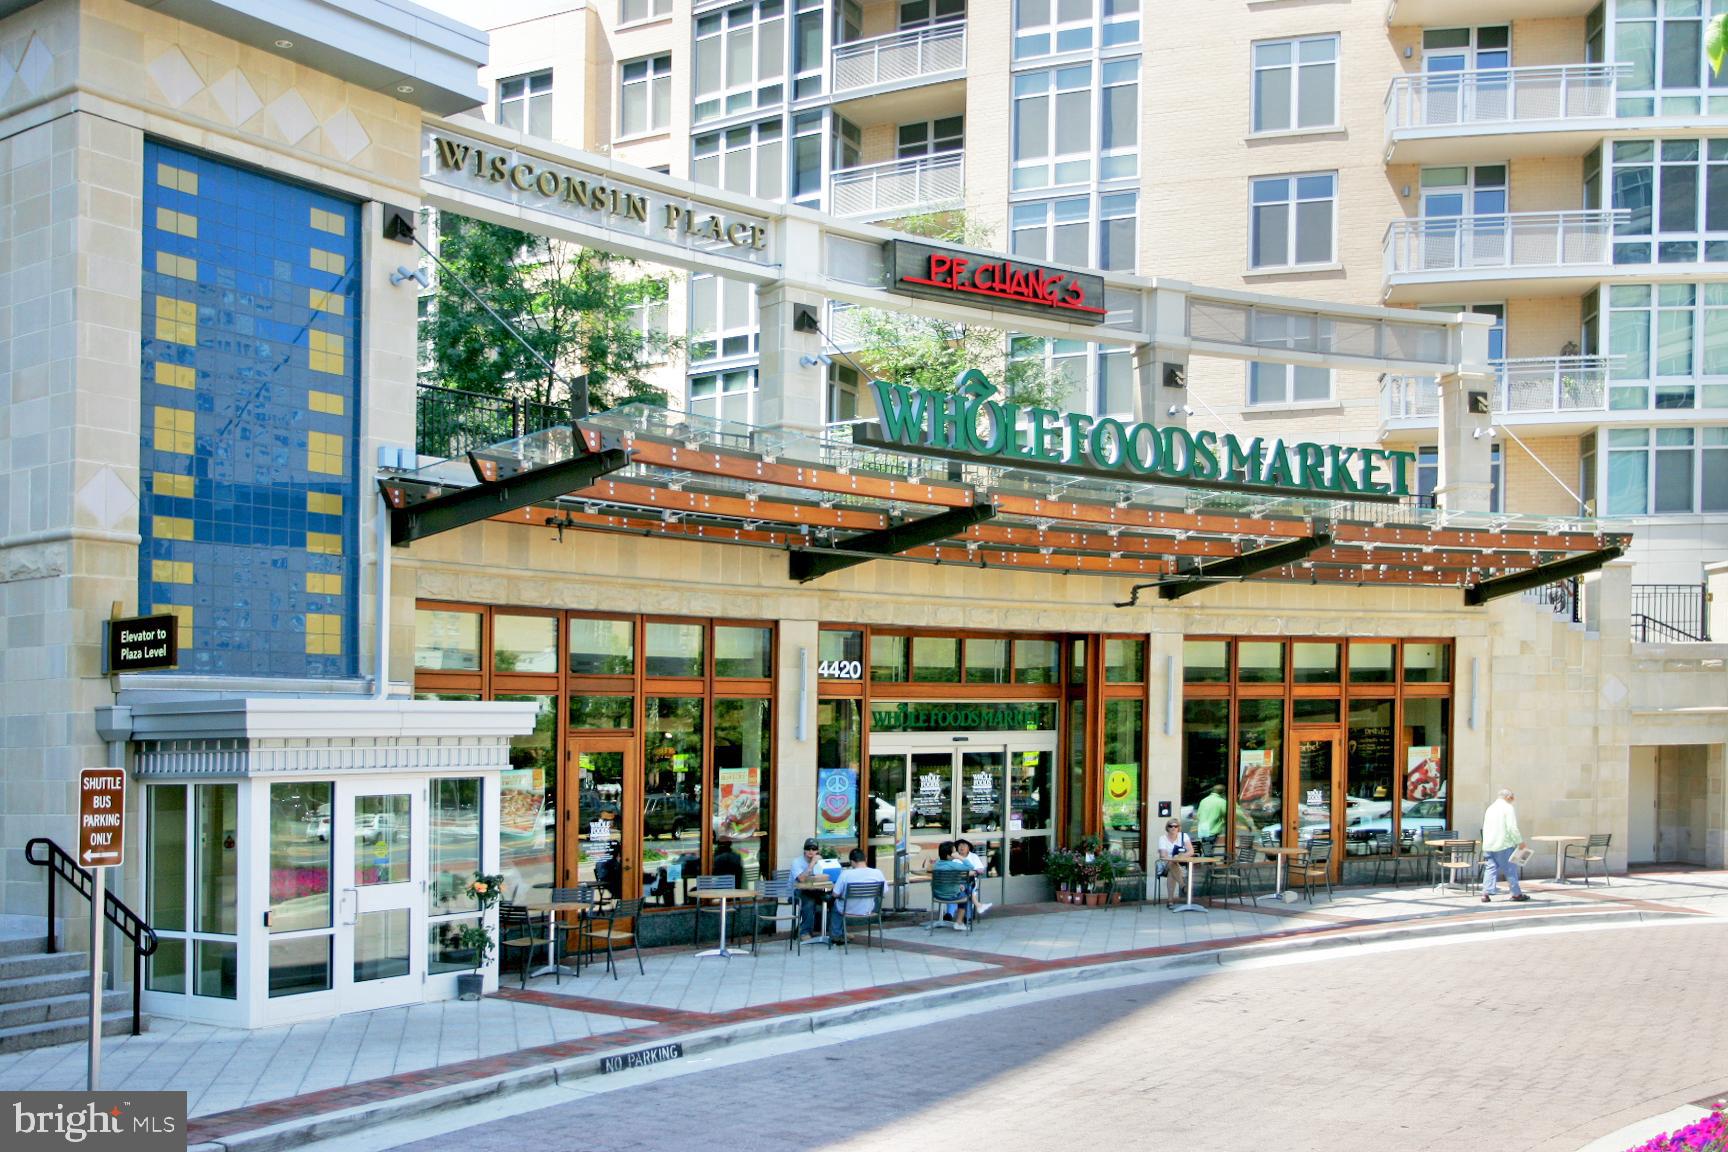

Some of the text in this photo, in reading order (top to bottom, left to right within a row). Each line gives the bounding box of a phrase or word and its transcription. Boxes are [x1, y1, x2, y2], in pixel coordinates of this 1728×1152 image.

[434, 136, 767, 250] WISCONSIN PLACE
[929, 253, 1087, 308] P.F. CHANG'S
[867, 369, 1417, 496] WHOLE FOODS MARKET
[121, 628, 166, 643] Elevator to
[121, 644, 166, 660] Plaza Level
[818, 660, 861, 679] 4420
[872, 703, 929, 728] WHOLE
[930, 710, 980, 727] FOODS
[83, 776, 122, 790] SHUTTLE
[93, 795, 112, 808] BUS
[83, 813, 120, 827] PARKING
[90, 832, 112, 846] ONLY
[605, 1045, 678, 1073] NO PARKING
